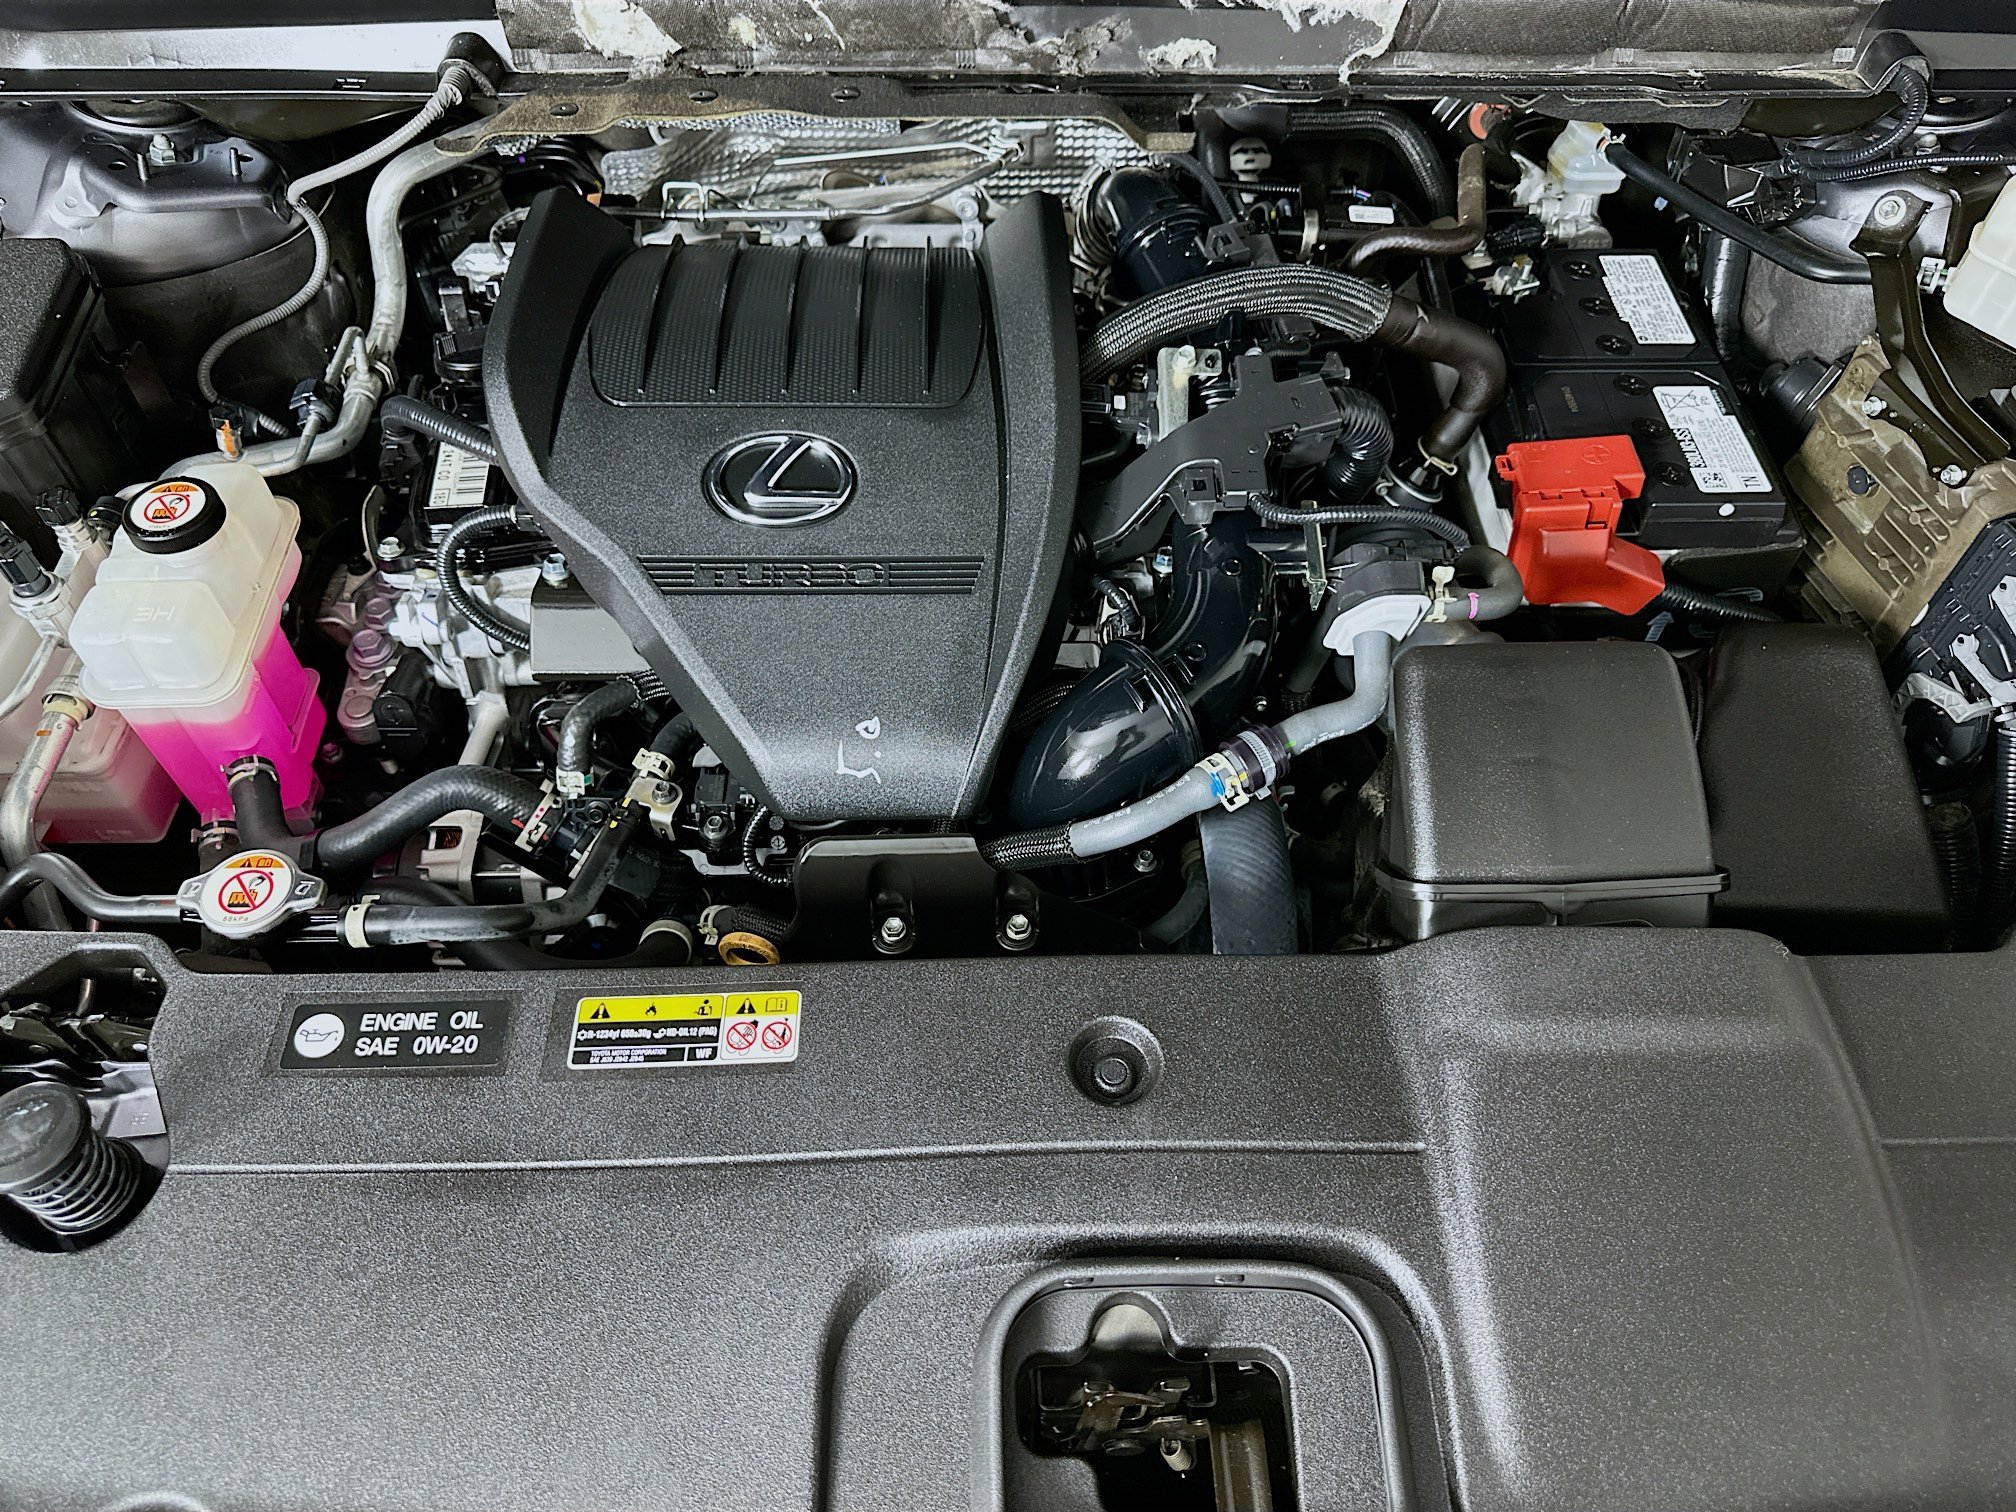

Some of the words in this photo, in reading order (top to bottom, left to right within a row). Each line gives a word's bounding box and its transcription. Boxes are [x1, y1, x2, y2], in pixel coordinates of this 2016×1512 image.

[699, 563, 884, 586] TURBO
[360, 1012, 438, 1032] ENGINE
[449, 1010, 484, 1030] OIL
[354, 1036, 400, 1057] SAE
[412, 1034, 479, 1055] 0W-20
[591, 1050, 611, 1058] TOYOTA
[611, 1049, 630, 1057] MOTOR
[630, 1048, 667, 1056] CORPORATION
